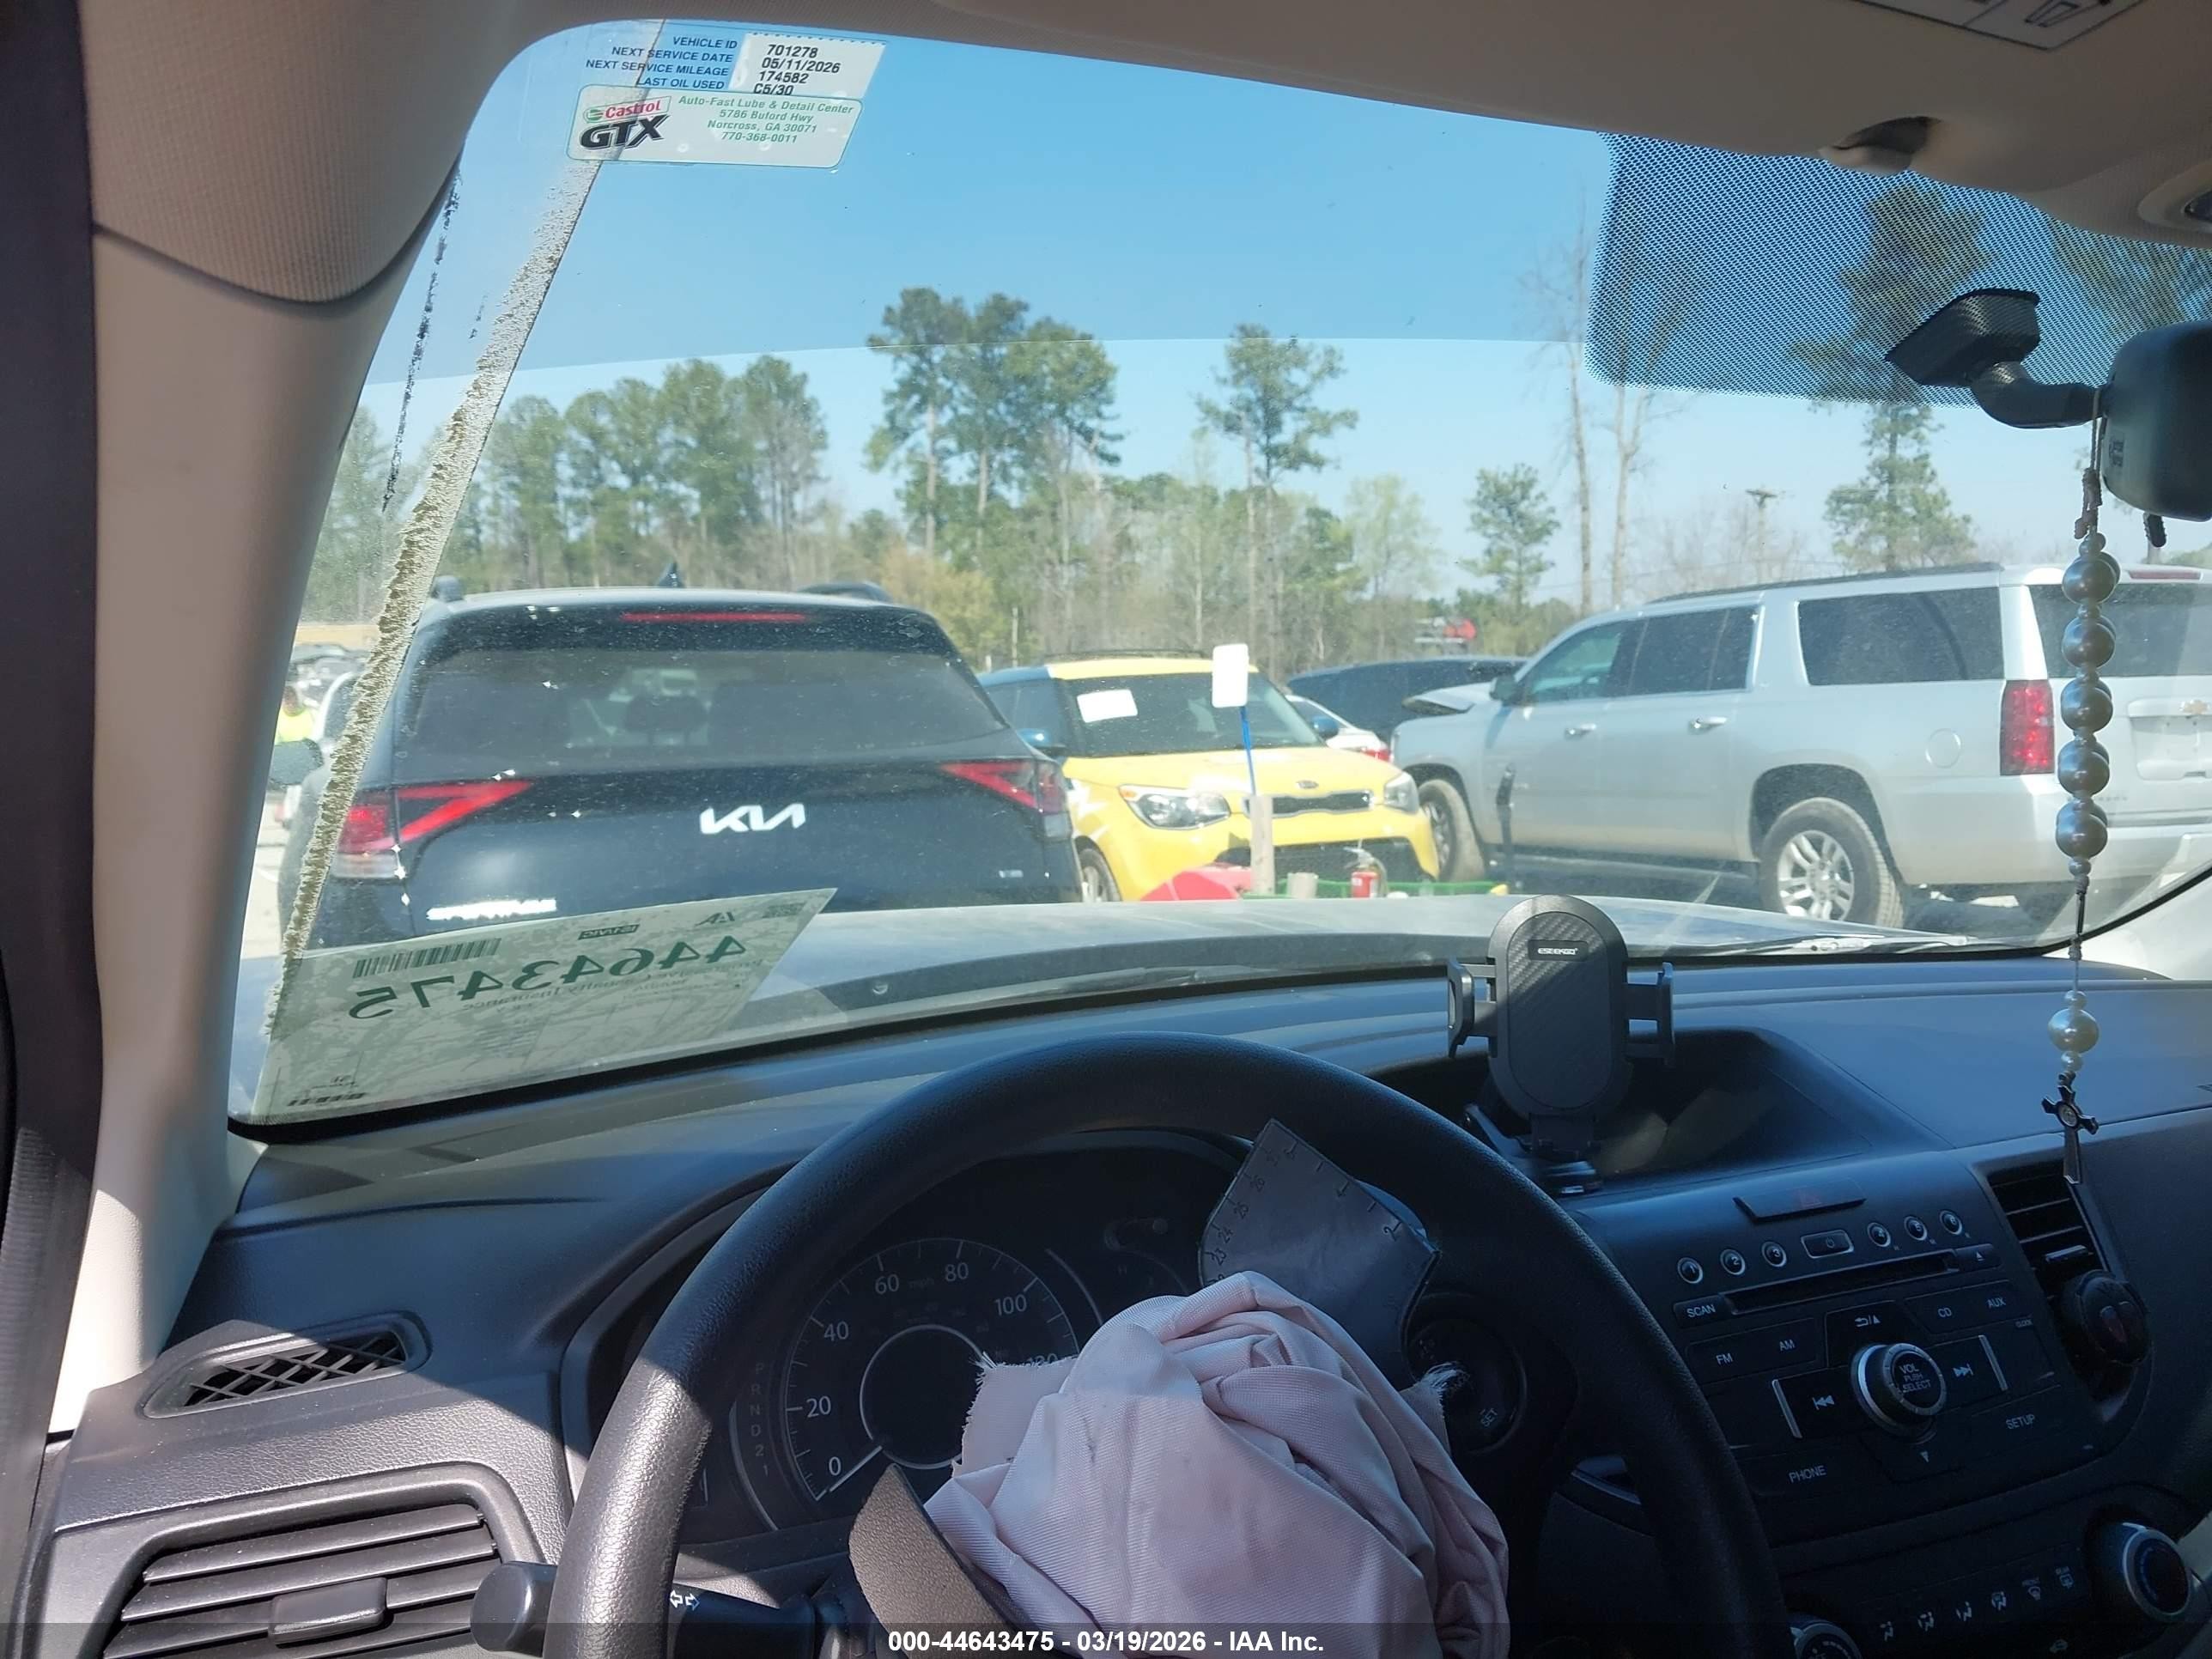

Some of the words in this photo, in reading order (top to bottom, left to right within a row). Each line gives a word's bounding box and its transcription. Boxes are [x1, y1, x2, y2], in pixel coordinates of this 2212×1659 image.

[672, 36, 724, 48] VEHICLE
[725, 40, 738, 49] ID
[611, 46, 644, 57] NEXT
[647, 49, 700, 61] SERVICE
[701, 52, 733, 63] DATE
[767, 45, 818, 58] 701278
[586, 59, 619, 70] NEXT
[622, 61, 674, 73] SERVICE
[676, 64, 729, 76] MILEAGE
[762, 57, 842, 74] 05/11/2026
[636, 76, 666, 87] LAST
[670, 78, 689, 88] OIL
[692, 79, 725, 89] USED
[759, 70, 810, 84] 174582
[605, 100, 661, 118] Castrol
[678, 95, 735, 107] Auto-Fast
[738, 98, 765, 109] Lube
[781, 100, 815, 112] Detail
[817, 103, 855, 114] Center
[719, 109, 748, 118] 5786
[750, 110, 787, 121] Buford
[790, 112, 814, 123] Hwy
[580, 114, 670, 149] GTX
[708, 119, 761, 132] Norcross,
[765, 123, 781, 131] GA
[783, 124, 817, 133] 30071
[721, 131, 798, 143] 770-368-0011
[1209, 1248, 1227, 1266] 23
[1731, 1255, 1741, 1267] 2
[1771, 1247, 1780, 1258] 3
[945, 1262, 969, 1283] 80
[875, 1273, 899, 1295] 60
[994, 1292, 1028, 1317] 100
[1985, 1296, 2007, 1309] AUX
[1686, 1304, 1717, 1318] SCAN
[1937, 1307, 1952, 1318] CD
[823, 1320, 849, 1342] 40
[1779, 1339, 1796, 1352] AM
[1716, 1352, 1734, 1365] FM
[1899, 1362, 1919, 1375] VOL
[750, 1383, 762, 1395] R
[1902, 1378, 1932, 1394] SELECT
[749, 1404, 762, 1415] N
[805, 1395, 832, 1418] 20
[2005, 1413, 2036, 1430] SETUP
[750, 1424, 762, 1437] D
[755, 1444, 764, 1456] 2
[829, 1456, 842, 1476] 0
[1789, 1464, 1827, 1484] PHONE
